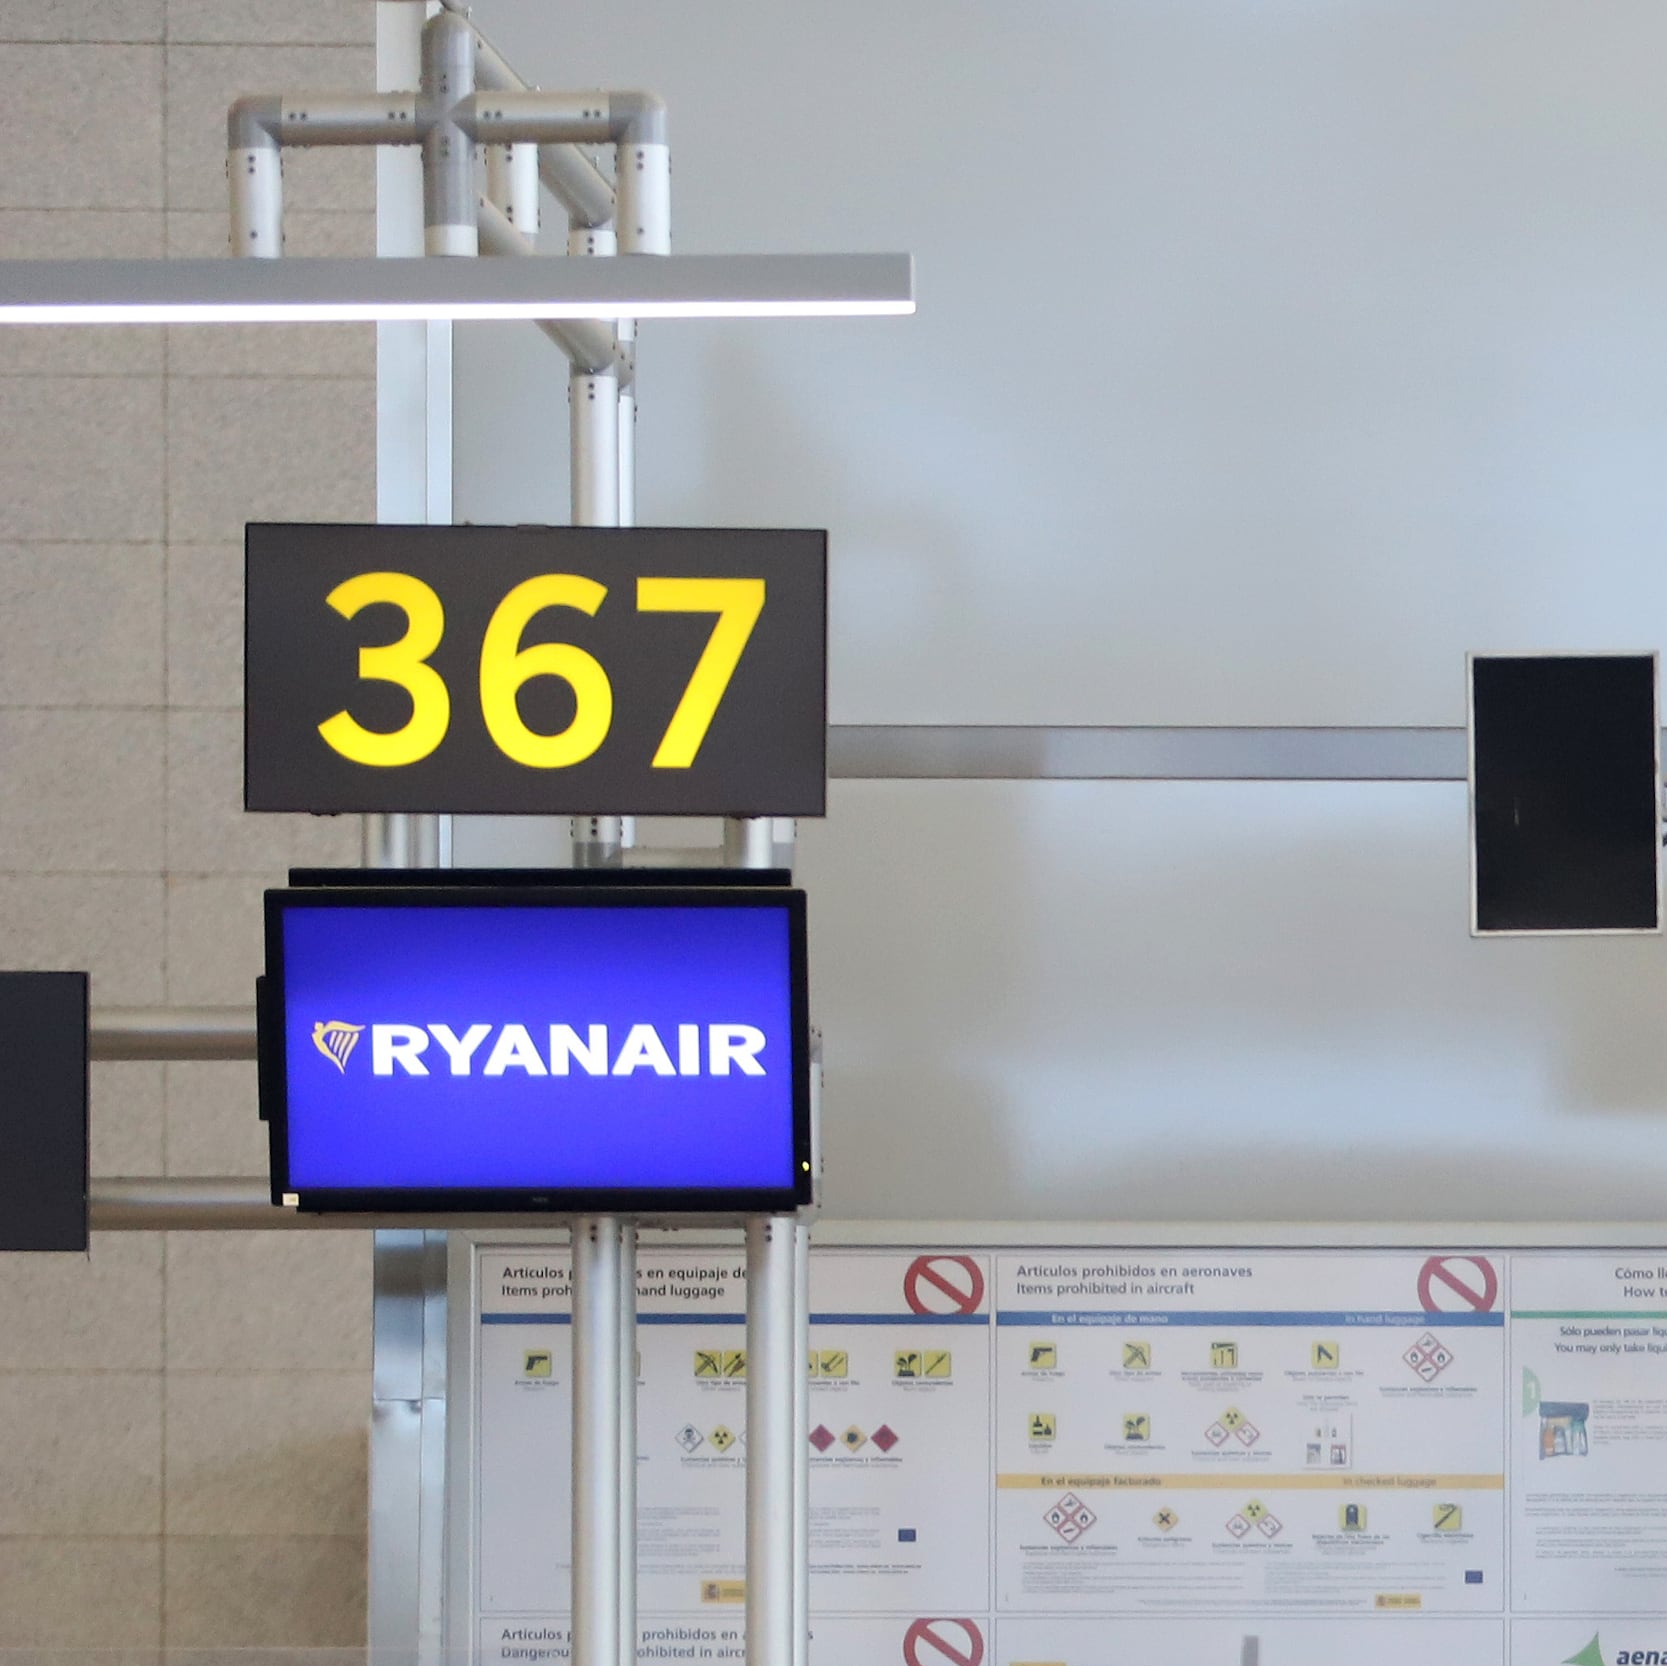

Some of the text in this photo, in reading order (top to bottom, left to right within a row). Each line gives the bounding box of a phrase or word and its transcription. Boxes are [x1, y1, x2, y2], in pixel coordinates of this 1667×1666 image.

[318, 572, 766, 769] 367
[372, 1024, 766, 1076] RYANAIR
[647, 1270, 663, 1278] en
[669, 1267, 727, 1281] equipaje
[1082, 1265, 1155, 1280] prohibidos
[1160, 1268, 1177, 1277] en
[1182, 1268, 1252, 1277] aeronaves
[502, 1285, 537, 1296] Items
[1017, 1282, 1194, 1296] Items prohibited in aircraft
[1624, 1286, 1655, 1297] How
[642, 1628, 716, 1642] prohibidos
[721, 1632, 737, 1640] en
[502, 1648, 569, 1661] Dangerou
[637, 1646, 695, 1658] ohibited
